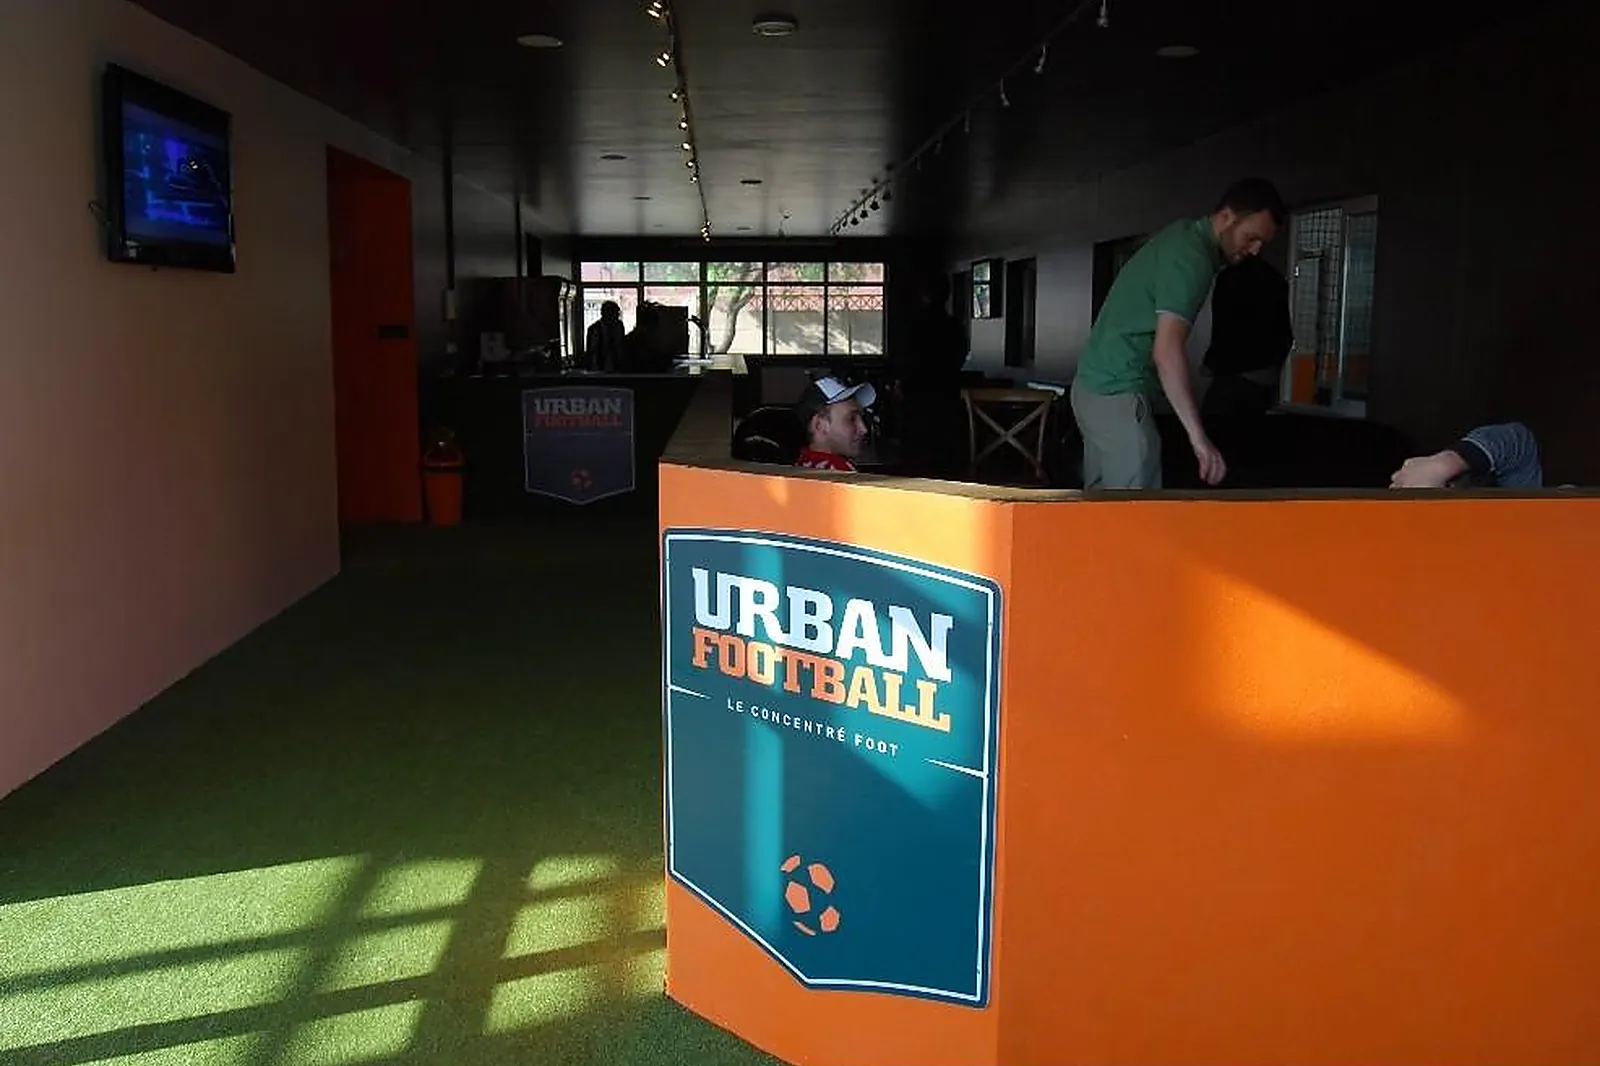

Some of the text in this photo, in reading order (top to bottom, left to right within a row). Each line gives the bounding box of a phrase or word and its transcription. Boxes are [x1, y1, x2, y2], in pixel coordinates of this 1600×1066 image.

[534, 398, 622, 416] URBAN
[692, 568, 953, 682] URBAN
[692, 628, 951, 732] FOOTBALL
[727, 698, 899, 756] LE CONCENTRÉ FOOT
